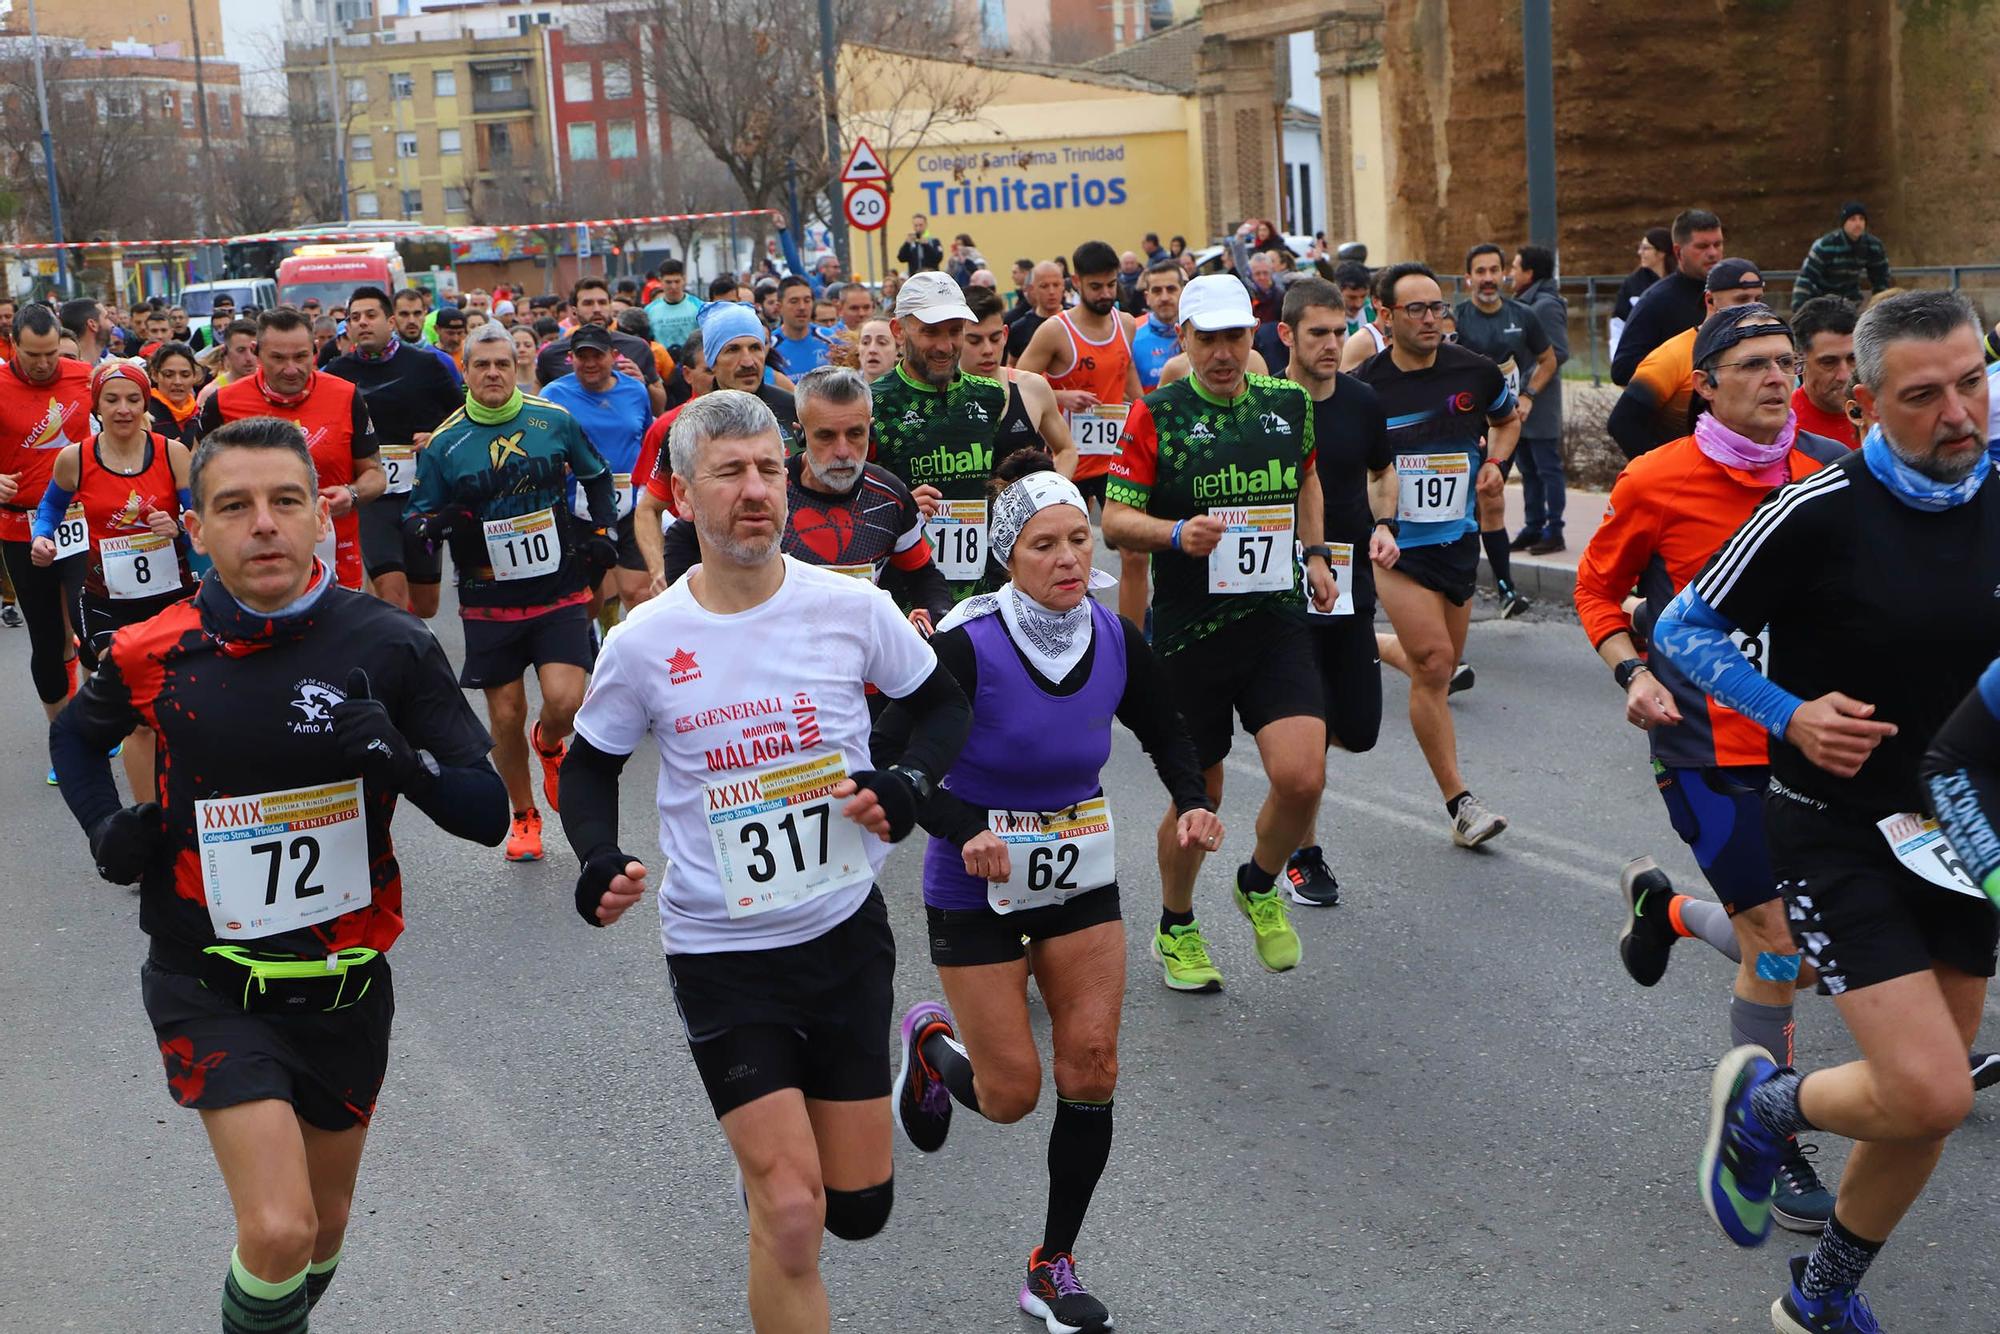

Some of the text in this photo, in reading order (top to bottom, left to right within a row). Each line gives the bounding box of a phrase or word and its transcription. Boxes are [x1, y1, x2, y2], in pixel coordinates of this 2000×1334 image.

[917, 154, 977, 172] Colegio
[1062, 145, 1125, 163] Trinidad
[920, 173, 1127, 216] Trinitarios
[855, 199, 880, 216] 20
[1081, 421, 1118, 444] 219
[1400, 457, 1428, 469] XXXIX
[1414, 476, 1457, 508] 197
[57, 521, 84, 548] 89
[487, 521, 515, 535] XXXIX
[103, 540, 131, 552] XXXIX
[504, 533, 550, 567] 110
[935, 527, 978, 564] 118
[1238, 536, 1274, 575] 57
[133, 555, 152, 584] 8
[317, 681, 348, 699] ATLETISMO
[670, 670, 702, 686] luanvi
[694, 697, 785, 728] GENERALI
[742, 721, 787, 740] MARATÓN
[704, 732, 796, 773] MÁLAGA
[796, 770, 824, 782] TRINIDAD
[293, 789, 325, 801] POPULAR
[302, 796, 333, 808] TRINIDAD
[707, 778, 763, 811] XXXIX
[203, 801, 265, 829] XXXIX
[291, 809, 359, 831] TRINITARIOS
[711, 800, 783, 825] Colegio Stma. Trinidad
[994, 815, 1041, 833] XXXIX
[203, 824, 284, 843] Colegio Stma. Trinidad
[739, 802, 830, 883] 317
[1034, 833, 1056, 842] Trinidad
[1060, 823, 1110, 839] TRINITARIOS
[250, 836, 324, 906] 72
[1027, 843, 1080, 892] 62
